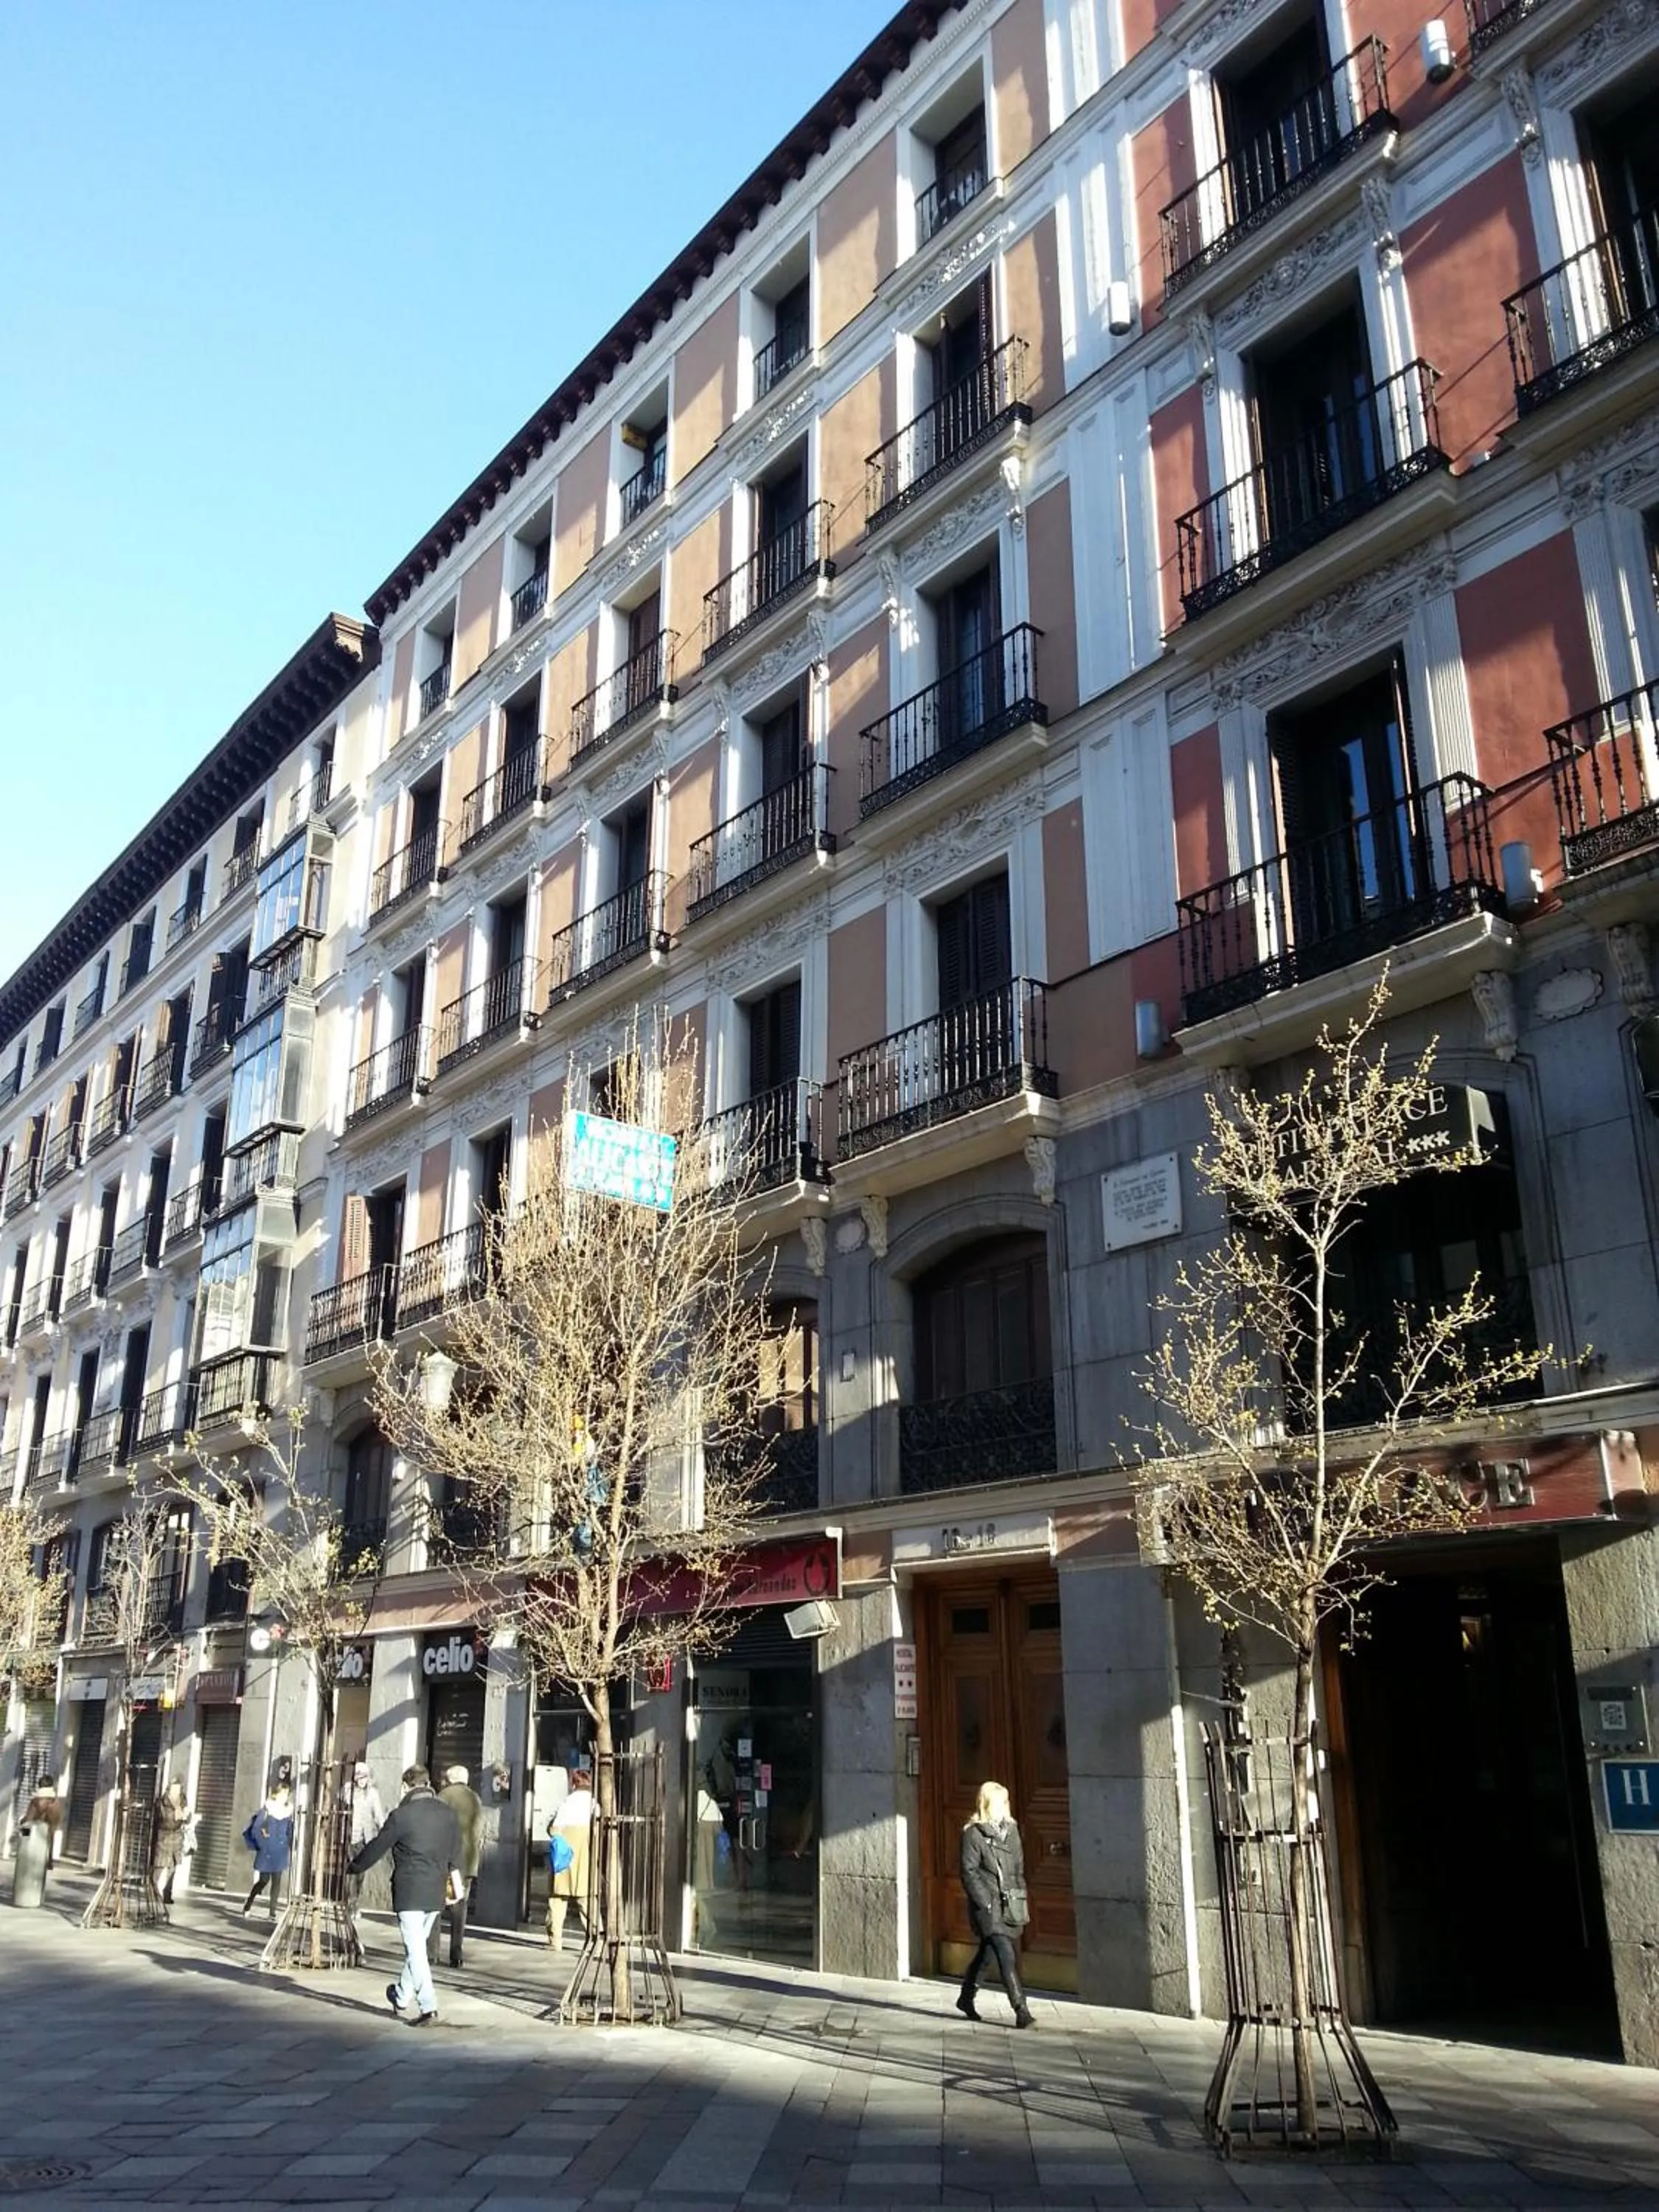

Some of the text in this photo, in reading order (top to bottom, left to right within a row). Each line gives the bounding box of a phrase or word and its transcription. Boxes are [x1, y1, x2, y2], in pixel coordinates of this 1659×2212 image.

[1283, 1139, 1399, 1185] ARAL
[335, 1645, 364, 1679] lio
[423, 1636, 474, 1675] celio
[1621, 1768, 1652, 1806] H
